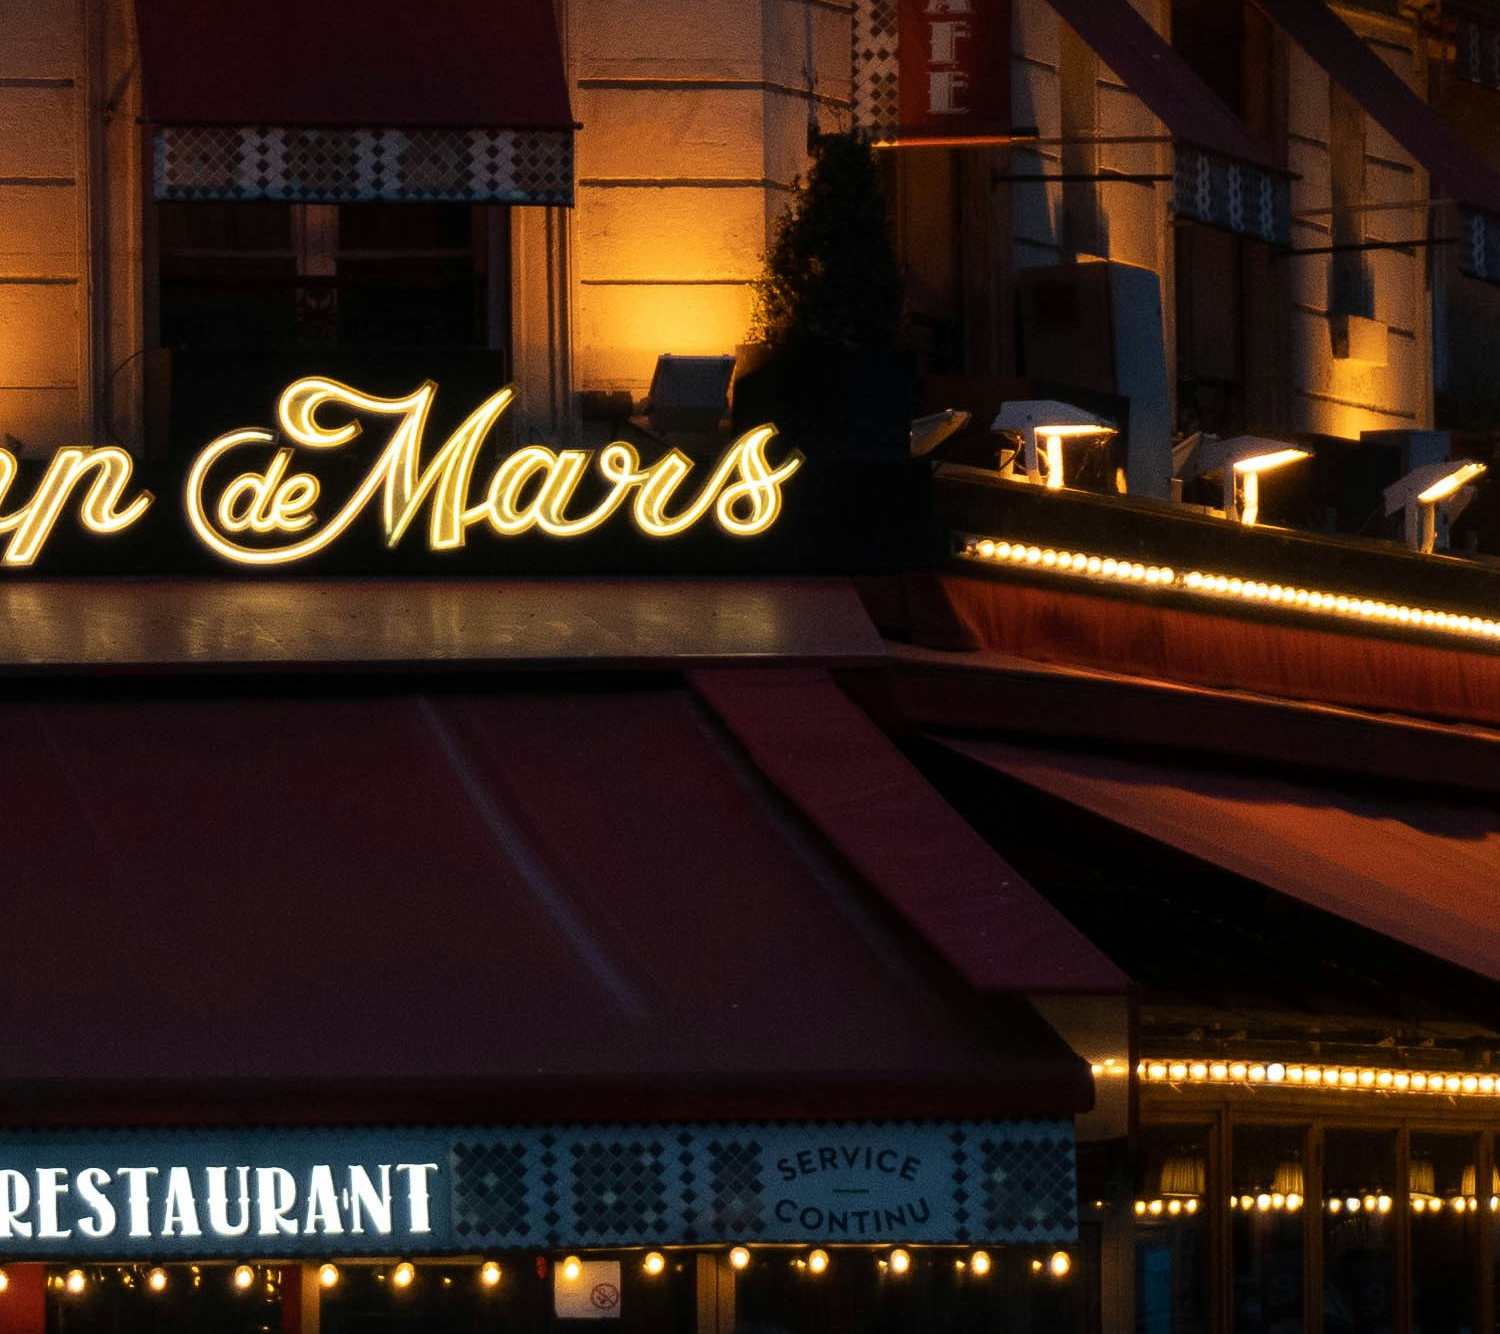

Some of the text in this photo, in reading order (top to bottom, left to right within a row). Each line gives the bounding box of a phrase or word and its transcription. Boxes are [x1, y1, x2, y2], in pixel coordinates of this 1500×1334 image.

[187, 375, 806, 564] Mars
[218, 446, 322, 534] de
[776, 1146, 922, 1182] SERVICE
[775, 1197, 931, 1235] CONTINU
